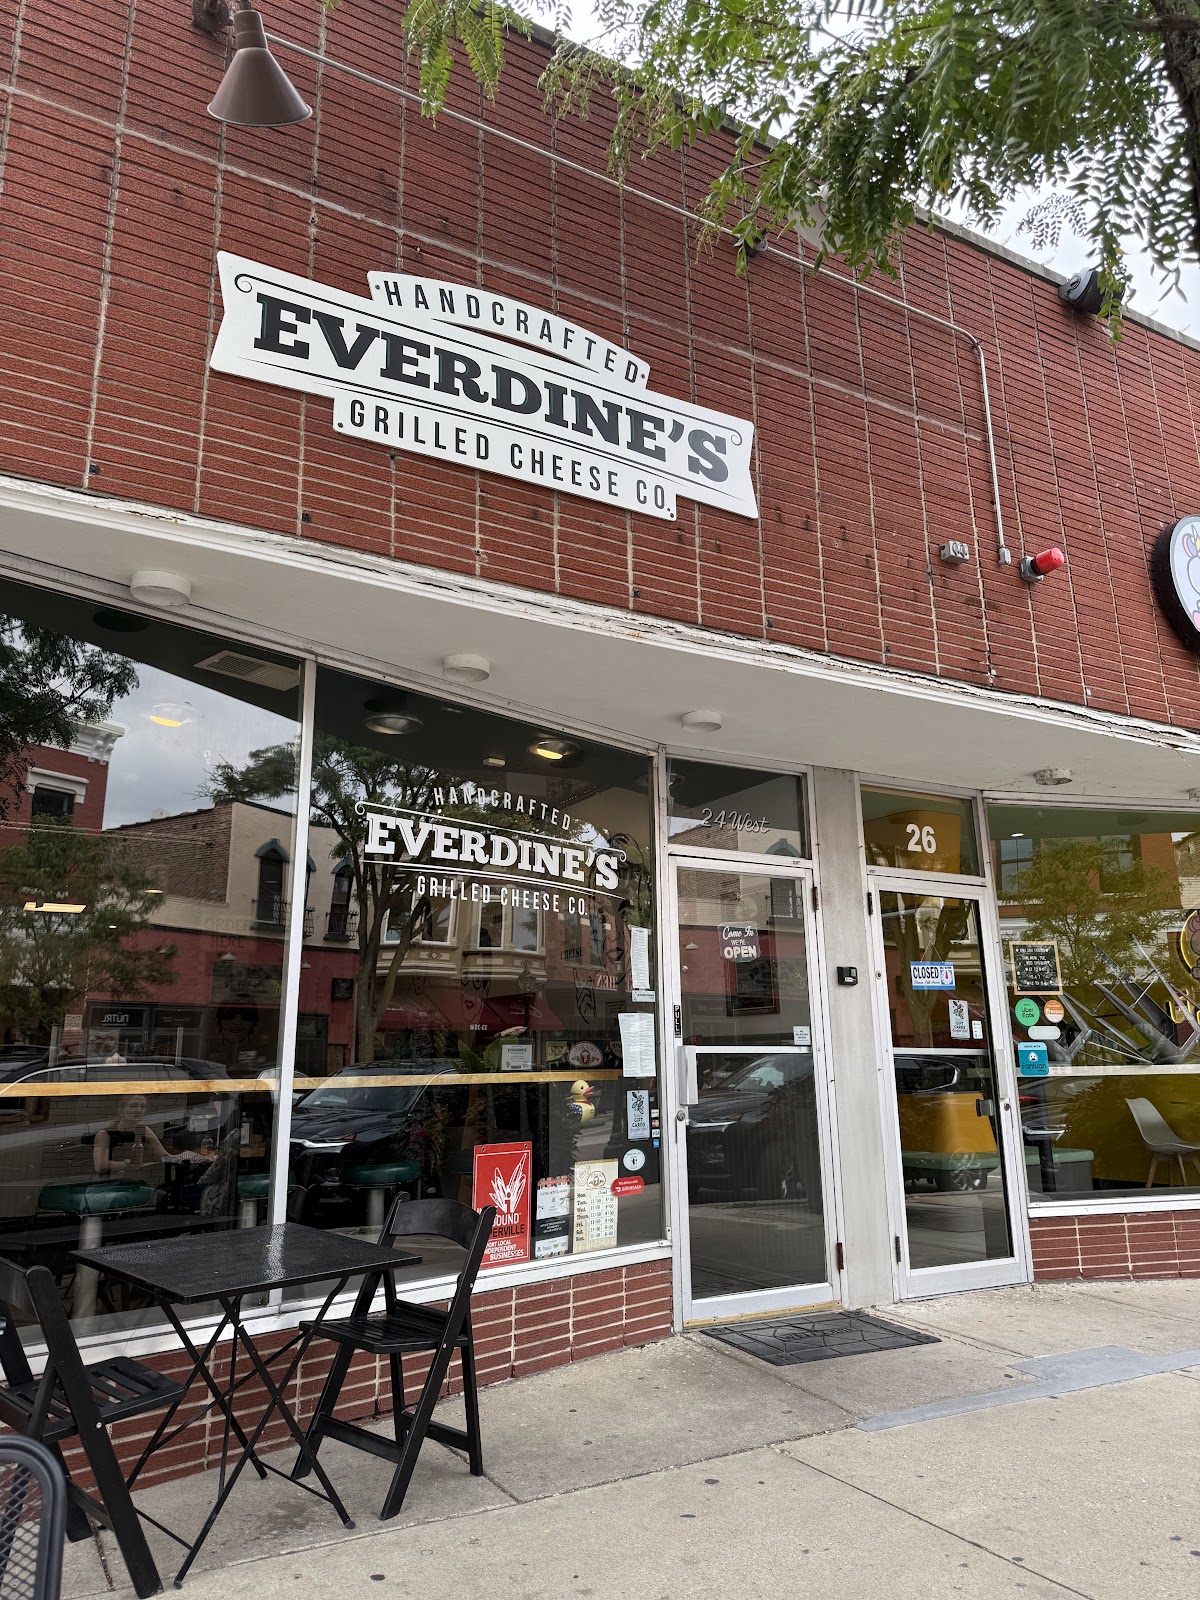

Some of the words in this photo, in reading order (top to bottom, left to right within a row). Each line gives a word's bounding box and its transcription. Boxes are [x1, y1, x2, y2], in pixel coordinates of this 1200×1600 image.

[383, 280, 639, 384] HANDCRAFTED
[253, 293, 730, 483] EVERDINE'S
[350, 399, 489, 461] GRILLED
[510, 443, 618, 497] CHEESE
[636, 480, 671, 512] CO.
[433, 787, 571, 831] HANDCRAFTED
[701, 808, 727, 829] 24
[729, 810, 771, 834] West
[364, 812, 619, 890] EVERDINE'S
[906, 823, 937, 854] 26
[417, 875, 491, 904] GRILLED
[500, 887, 560, 913] CHEESE
[568, 896, 588, 916] CO.
[722, 926, 742, 940] Come
[744, 926, 754, 937] In
[724, 945, 757, 959] OPEN
[912, 966, 939, 979] CLOSED
[490, 1224, 525, 1238] ERVILLE
[497, 1239, 512, 1247] LOCAL
[484, 1244, 517, 1255] NDEPENDENT
[490, 1249, 524, 1261] BUSINESSES
